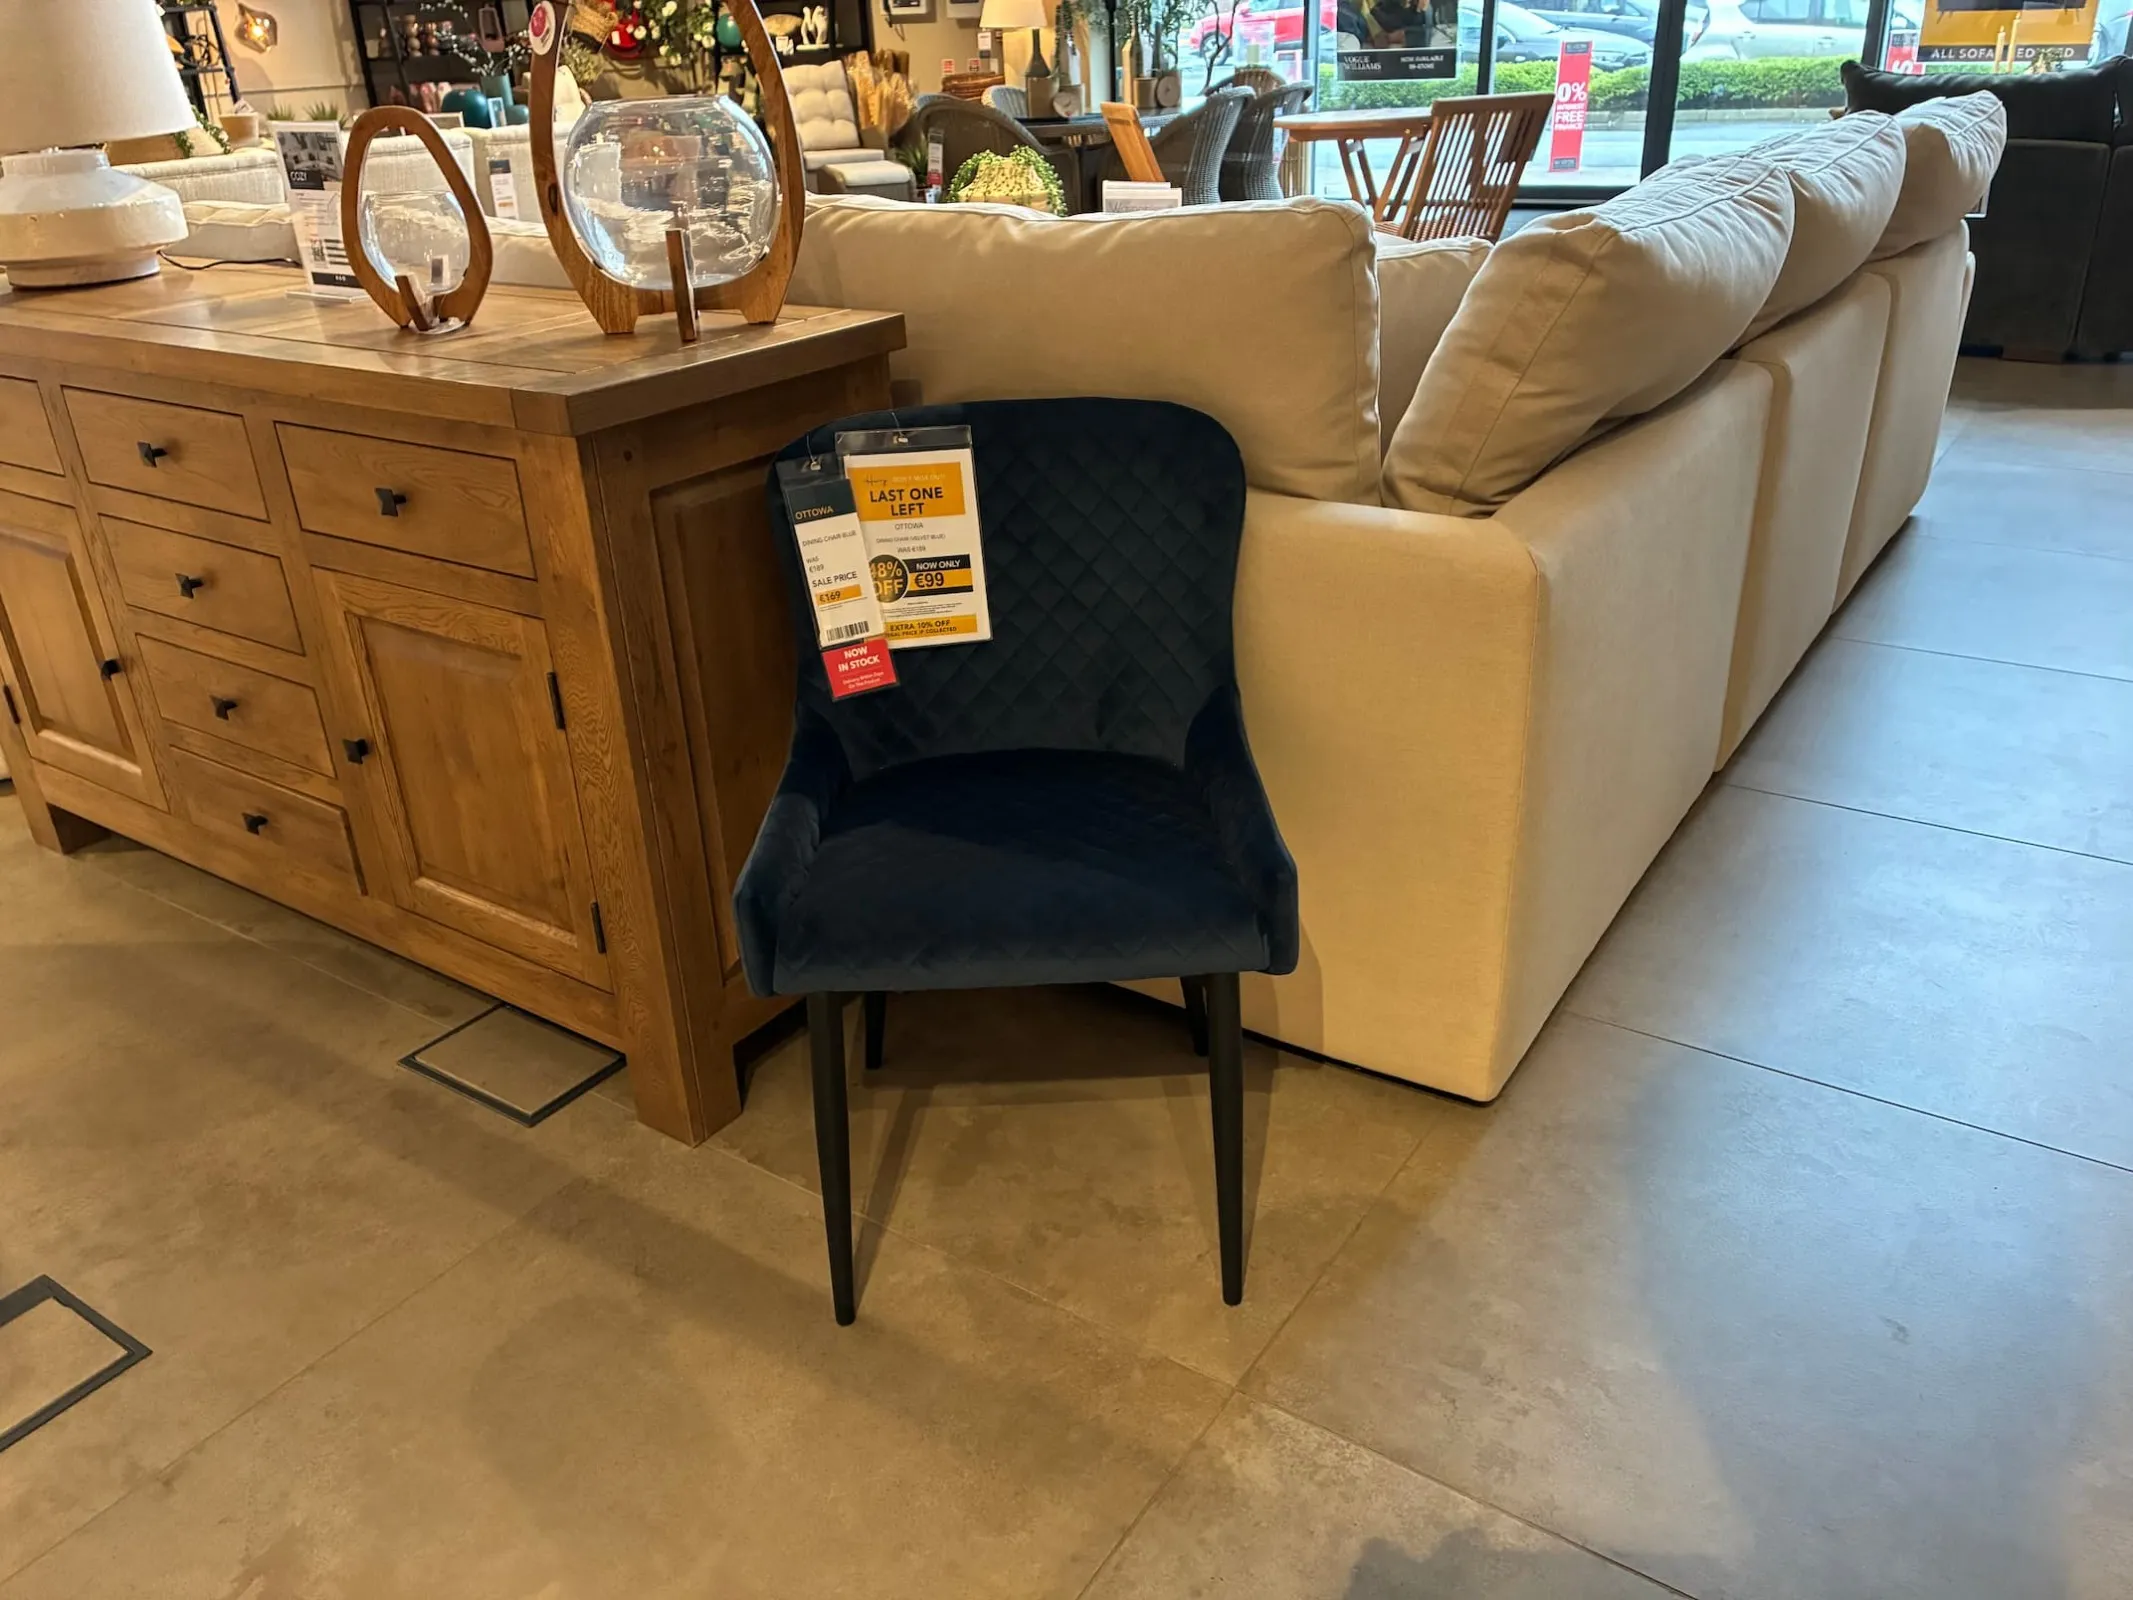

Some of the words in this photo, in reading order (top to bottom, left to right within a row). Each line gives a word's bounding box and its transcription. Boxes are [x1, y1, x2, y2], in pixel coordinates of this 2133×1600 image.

[1344, 55, 1371, 63] VOGUE
[1931, 48, 1955, 59] ALL
[1959, 47, 1997, 59] SOFA
[1344, 63, 1382, 71] WILLIAMS
[1556, 110, 1585, 122] FREE
[870, 489, 905, 503] LAST
[909, 487, 944, 500] ONE
[795, 506, 834, 520] OTTOWA
[891, 503, 925, 516] LEFT
[895, 522, 924, 531] OTTOWA
[802, 537, 823, 547] DINING
[823, 533, 841, 542] CHAIR
[842, 530, 857, 538] BLUE
[806, 556, 819, 564] WAS
[916, 561, 937, 570] NOW
[938, 560, 961, 569] ONLY
[809, 564, 824, 573] €189
[812, 576, 833, 587] SALE
[834, 571, 858, 583] PRICE
[914, 572, 945, 588] €99
[819, 591, 841, 603] €169
[890, 623, 915, 631] EXTRA
[918, 621, 933, 629] 10%
[844, 646, 868, 659] NOW
[838, 663, 849, 673] IN
[849, 655, 880, 669] STOCK
